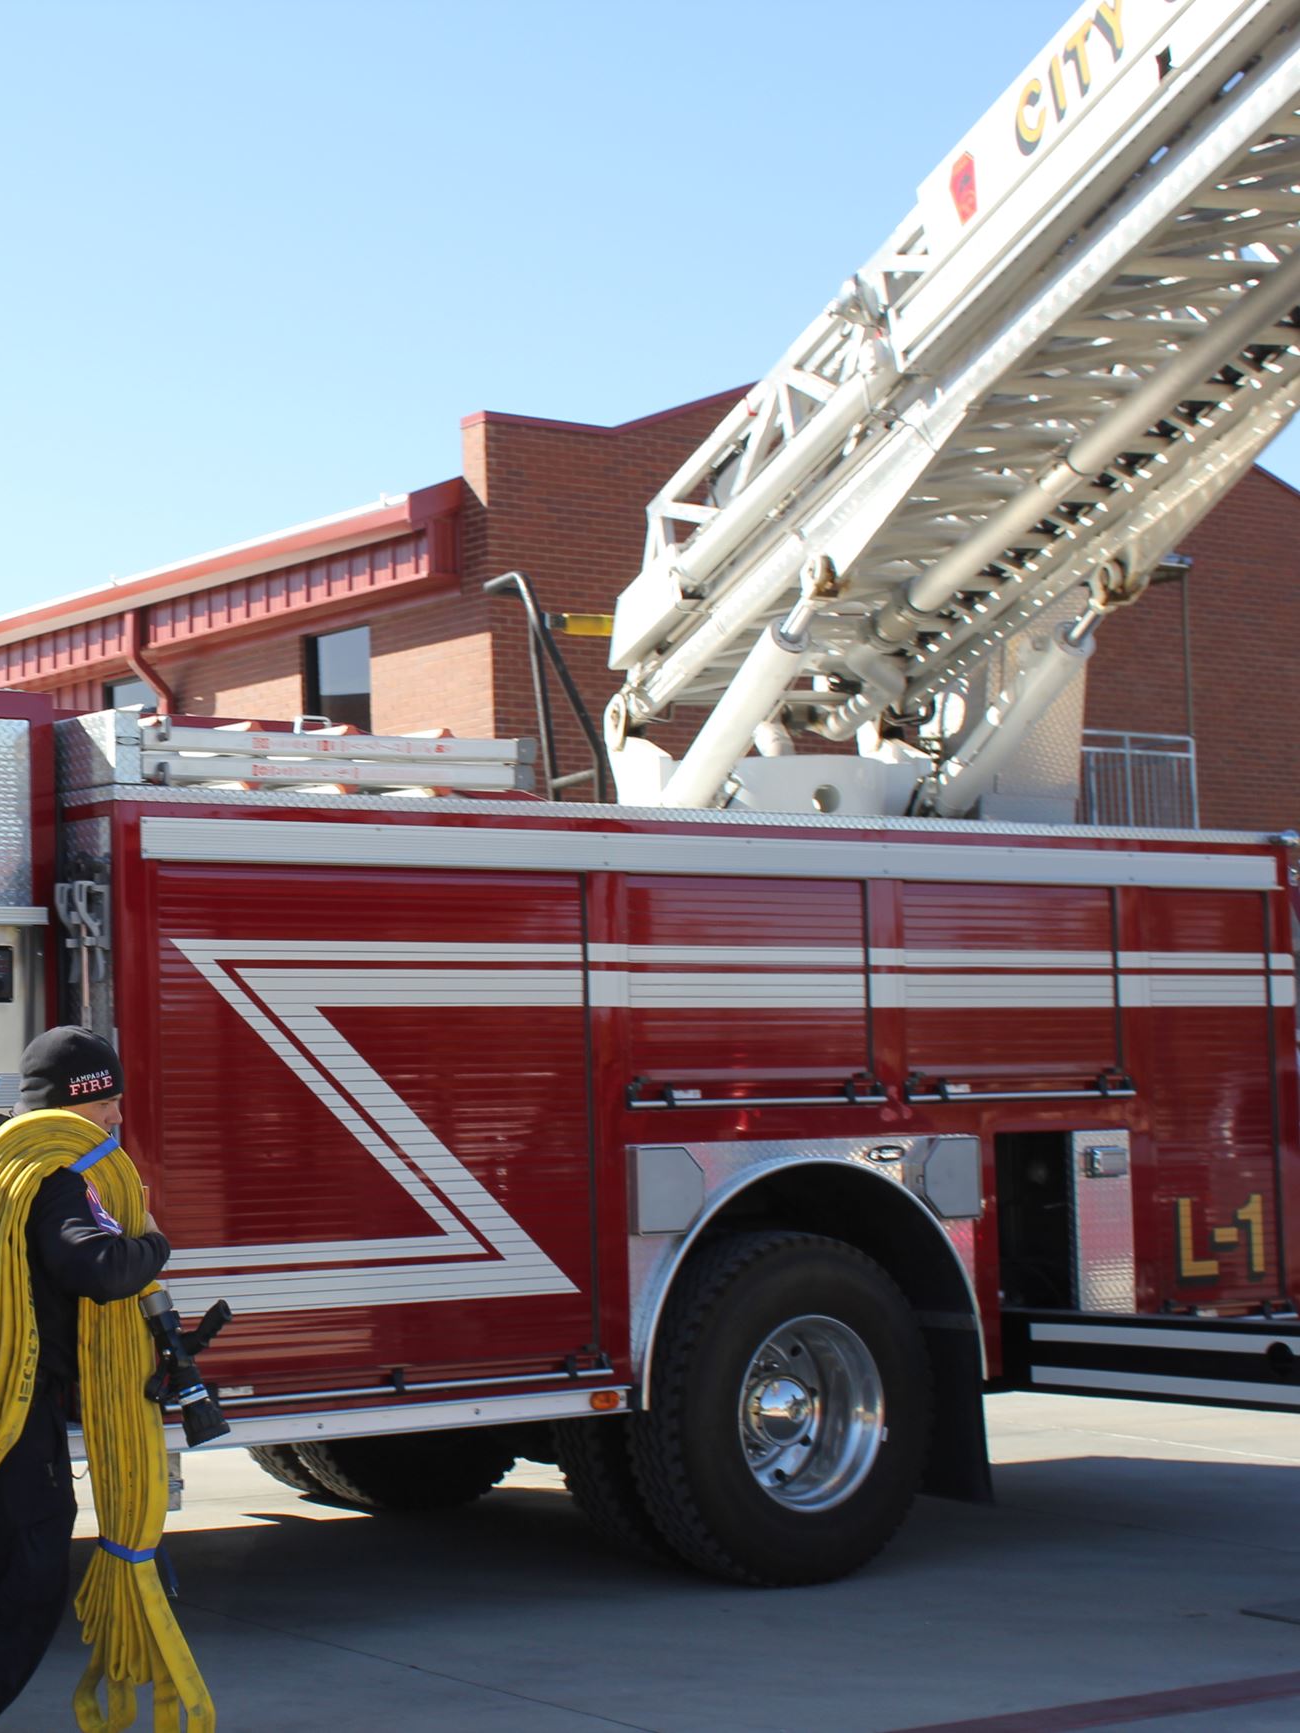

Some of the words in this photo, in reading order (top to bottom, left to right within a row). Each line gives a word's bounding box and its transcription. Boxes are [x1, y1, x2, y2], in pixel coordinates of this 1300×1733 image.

[1015, 0, 1124, 156] CITY
[69, 1069, 110, 1084] LAMPASAS
[69, 1075, 113, 1096] FIRE
[1176, 1193, 1266, 1281] L-1
